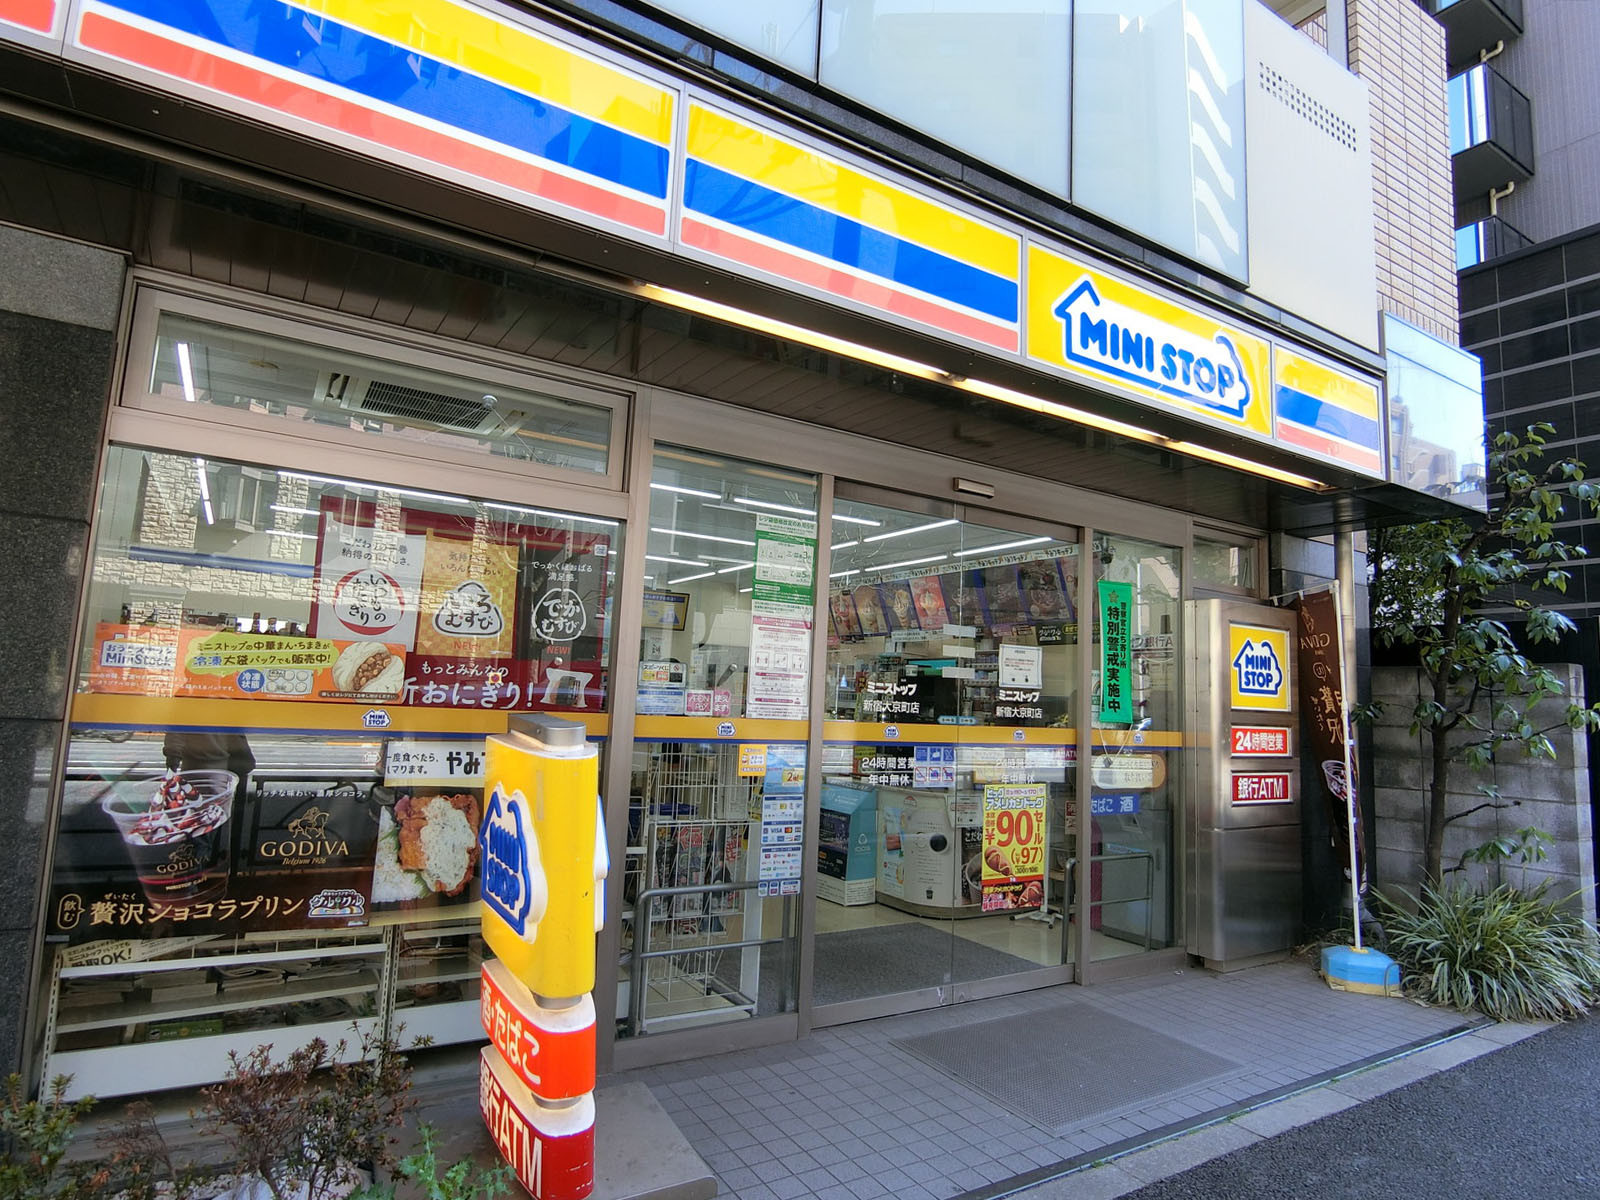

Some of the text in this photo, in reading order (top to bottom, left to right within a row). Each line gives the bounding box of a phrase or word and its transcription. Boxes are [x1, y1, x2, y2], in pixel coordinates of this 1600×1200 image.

[1080, 311, 1235, 399] MINI STOP
[543, 598, 580, 617] でか
[445, 610, 493, 630] むすび
[541, 617, 580, 634] むすび
[546, 646, 571, 655] NEW!
[1106, 605, 1121, 713] 特別警戒実施中
[1244, 654, 1272, 670] MINI
[866, 681, 917, 696] ミニストップ
[1244, 672, 1273, 688] STOP
[998, 690, 1040, 703] ミニストップ
[862, 699, 920, 714] 新宿大京町店
[996, 706, 1043, 719] 新宿大京町店
[1235, 731, 1284, 751] 24時間営業
[446, 751, 486, 775] やみ
[868, 774, 911, 786] 年中無休
[1237, 778, 1283, 799] 銀行ATM
[256, 789, 366, 799] リッチな味わい、濃厚ショコラ。
[986, 797, 1044, 810] アメリカンドッグ
[1119, 796, 1134, 813] 酒
[1034, 810, 1044, 845] セール
[261, 841, 349, 857] GODIVA
[489, 820, 521, 873] MINI
[157, 856, 210, 873] GODIVA
[487, 857, 521, 911] STOP
[63, 899, 76, 922] 飲む
[90, 895, 305, 926] 贅沢ショコラプリン
[480, 1057, 543, 1200] 銀行ATM
